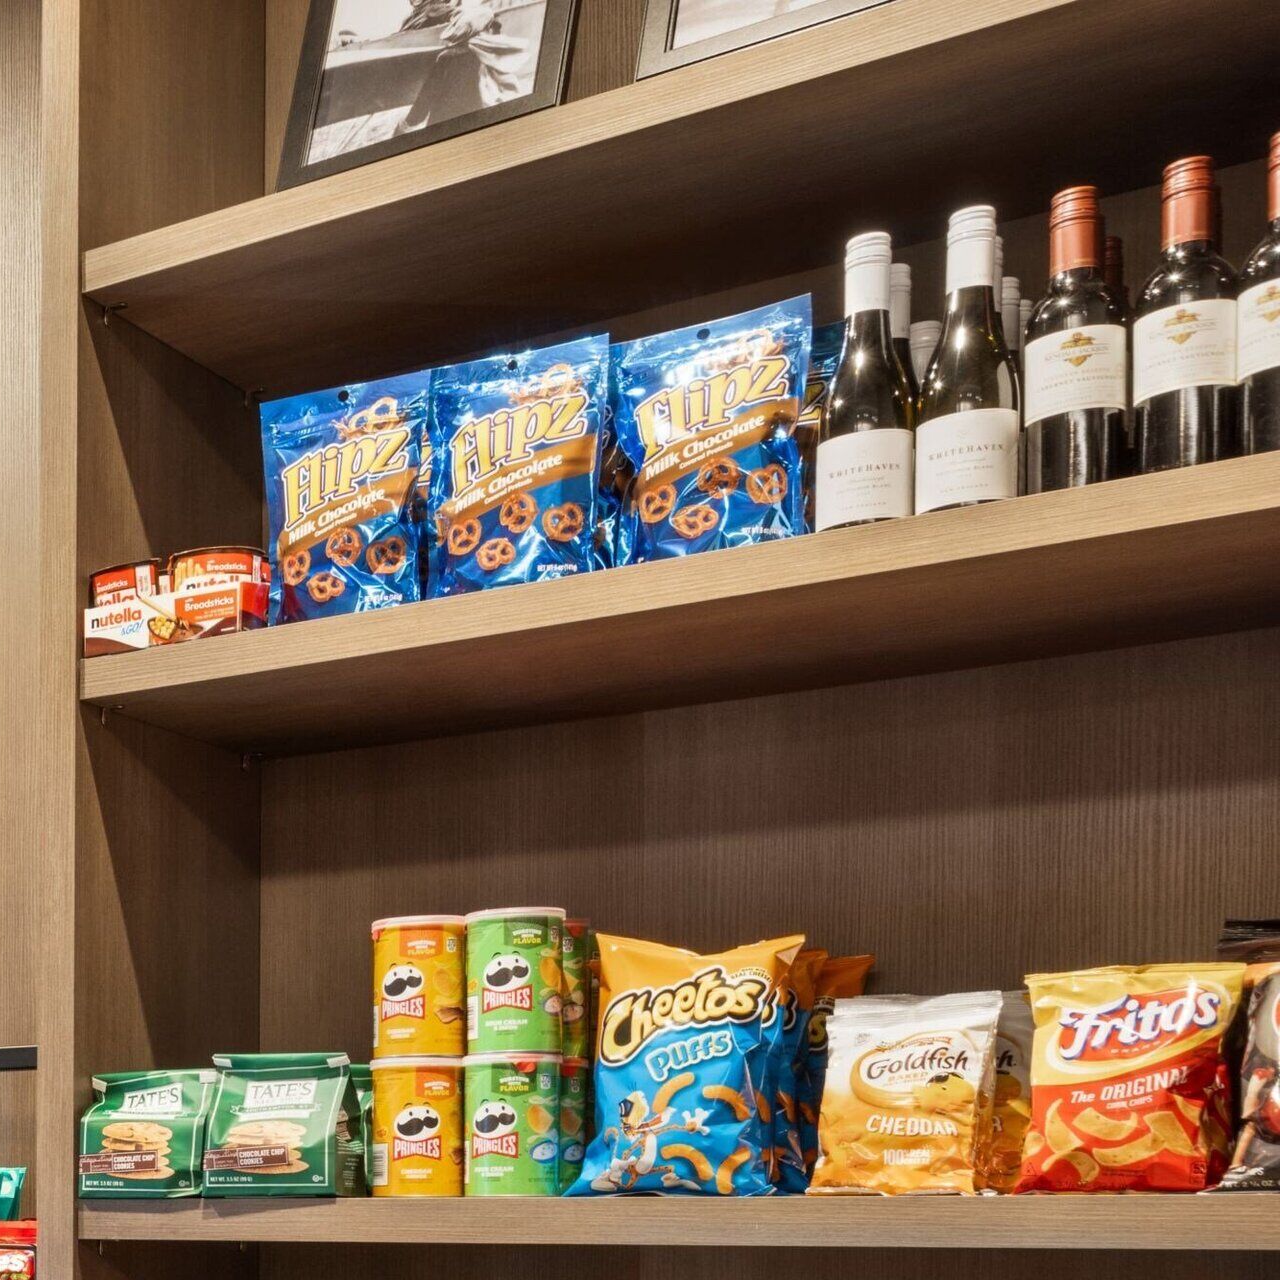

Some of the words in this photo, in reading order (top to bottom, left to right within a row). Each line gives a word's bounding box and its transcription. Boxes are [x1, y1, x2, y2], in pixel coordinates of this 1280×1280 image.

[635, 354, 789, 467] Flipz
[450, 389, 589, 499] Flipz
[645, 454, 680, 481] Milk
[682, 414, 765, 458] Chocolate
[281, 426, 411, 531] Flipz
[455, 488, 485, 513] Milk
[488, 454, 564, 494] Chocolate
[288, 522, 316, 545] Milk
[317, 489, 385, 525] Chocolate
[91, 608, 141, 629] nutella
[184, 596, 234, 612] Breadsticks
[382, 997, 424, 1020] PRINGLES
[483, 987, 531, 1013] PRINGLES
[601, 968, 766, 1064] Cheetos
[1058, 990, 1222, 1060] Fritos
[866, 1047, 970, 1080] Goldfish
[127, 1088, 179, 1109] TATE'S
[251, 1081, 313, 1099] TATE'S
[1071, 1090, 1095, 1104] The
[1100, 1066, 1189, 1101] ORIGINAL
[865, 1114, 958, 1136] CHEDDAR
[394, 1138, 440, 1160] PRINGLES
[472, 1135, 517, 1158] PRINGLES
